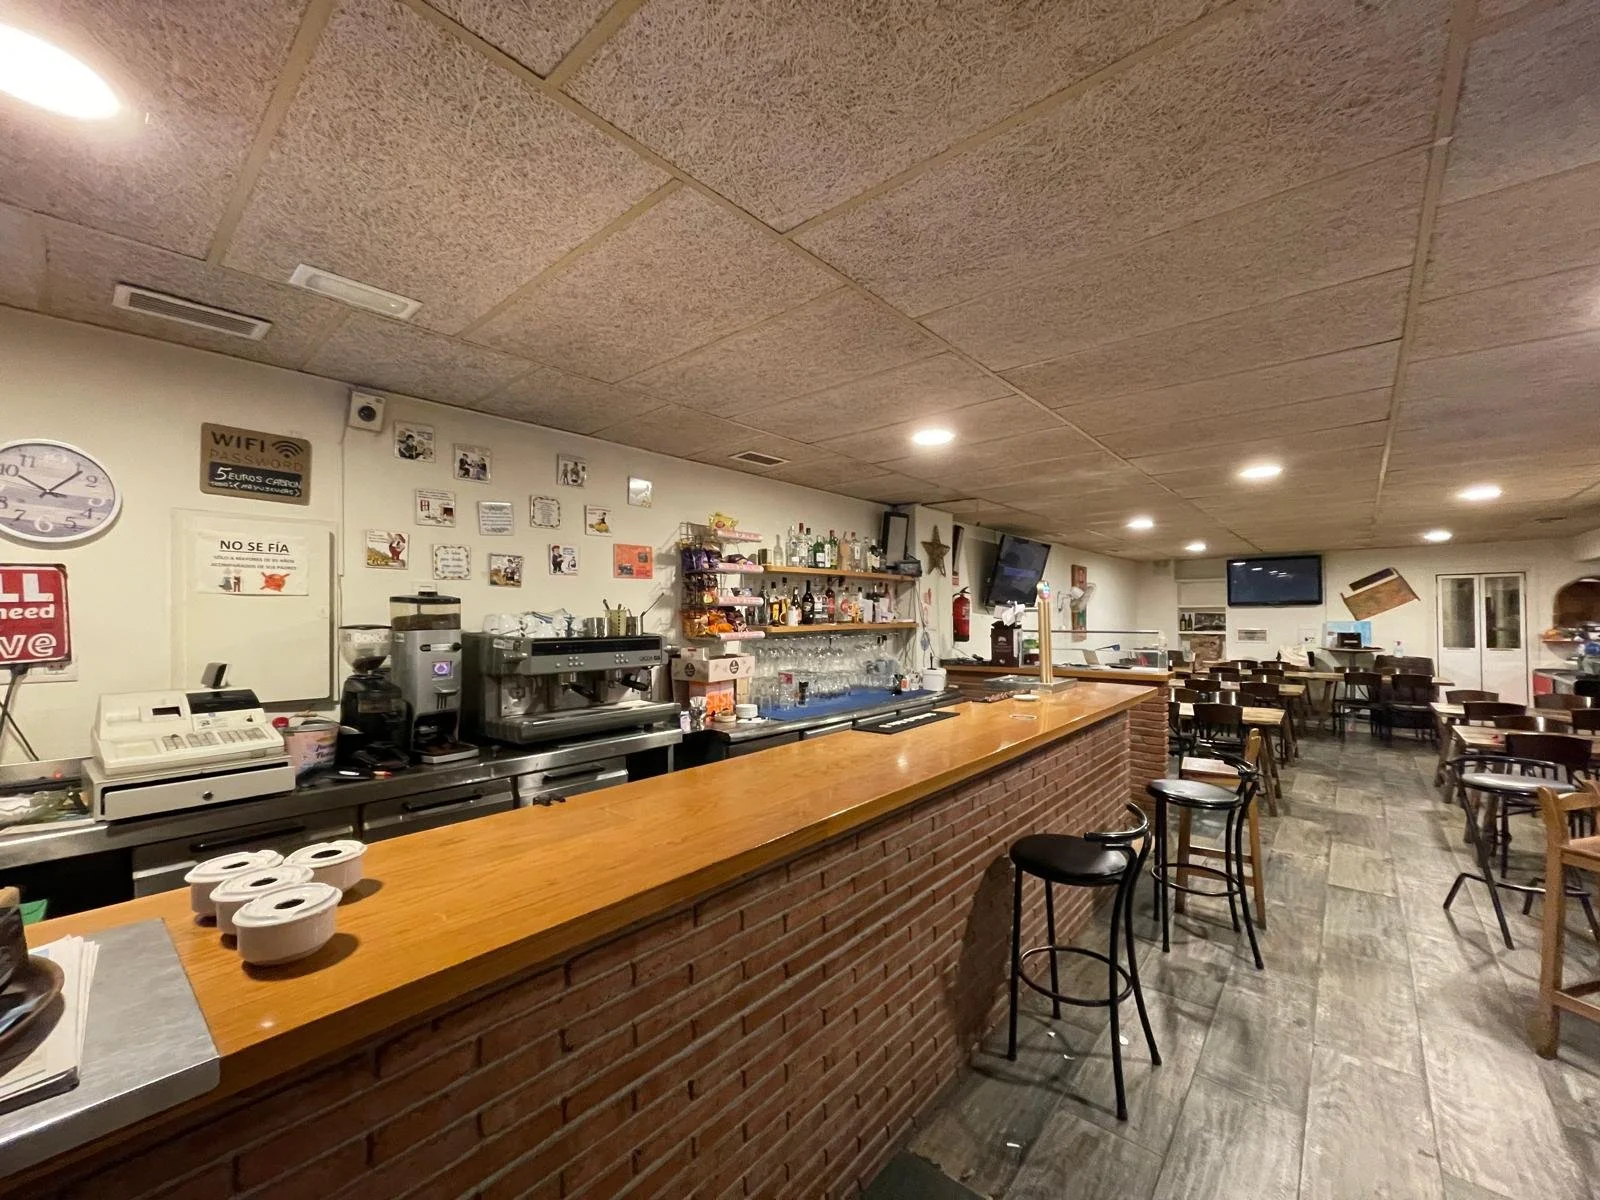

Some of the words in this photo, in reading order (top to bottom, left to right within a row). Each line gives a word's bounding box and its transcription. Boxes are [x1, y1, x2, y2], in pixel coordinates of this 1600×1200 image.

[211, 430, 265, 453] WIFI
[20, 454, 36, 468] 11
[209, 448, 304, 472] PASSWORD
[0, 463, 19, 477] 10
[214, 466, 232, 481] 5
[228, 472, 263, 484] EUROS
[12, 509, 26, 522] 7
[80, 508, 92, 519] 4
[34, 515, 53, 532] 6
[64, 516, 77, 529] 5
[220, 540, 243, 550] NO
[247, 541, 264, 552] SE
[268, 541, 290, 553] FÍA
